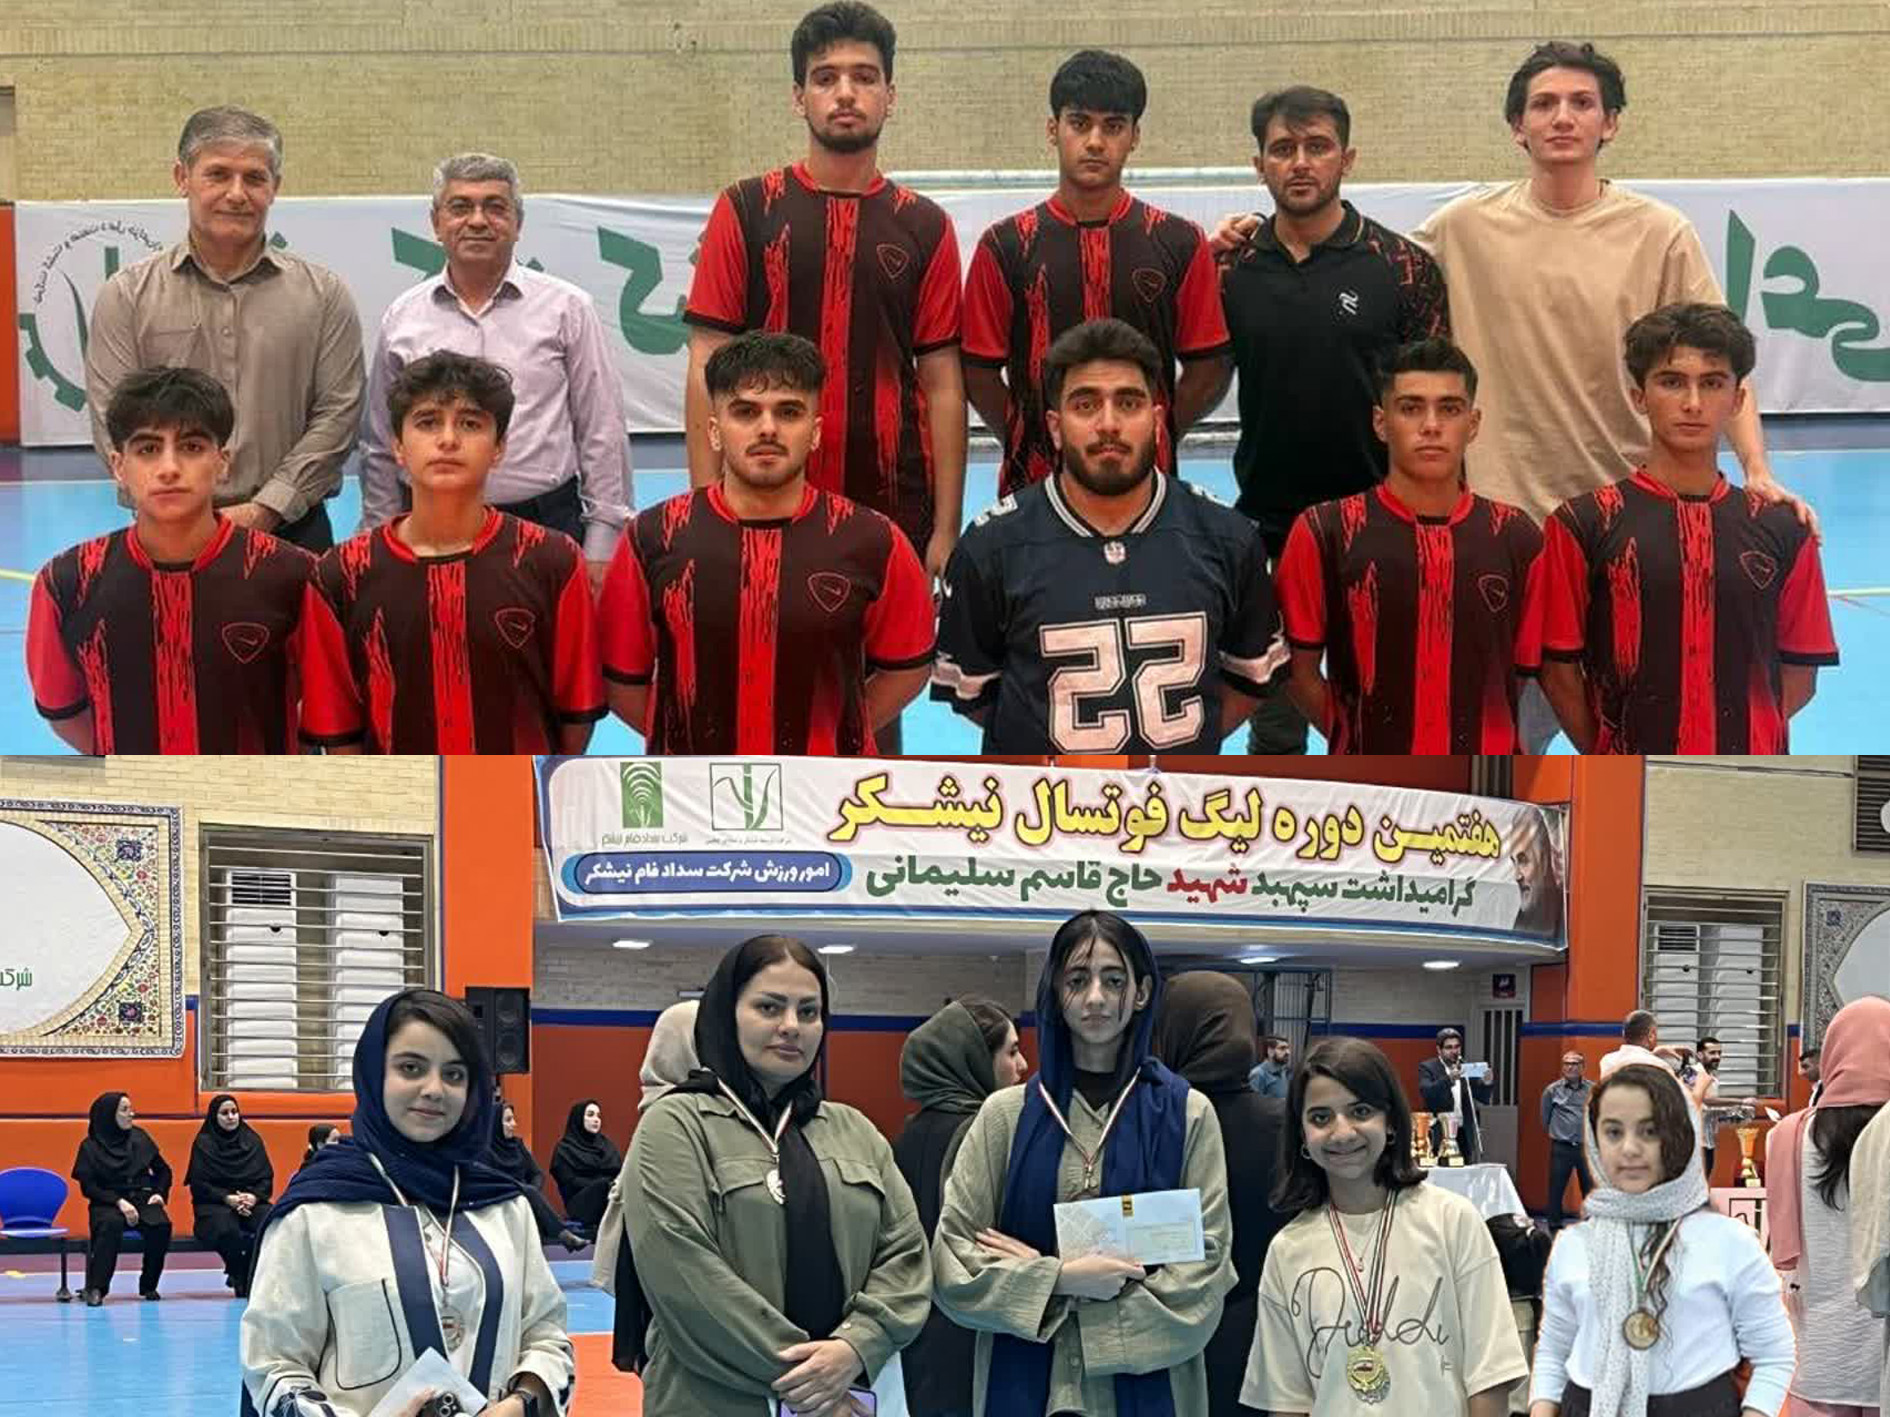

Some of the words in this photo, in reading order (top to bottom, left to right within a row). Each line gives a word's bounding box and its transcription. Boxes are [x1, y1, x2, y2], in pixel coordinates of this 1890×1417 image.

[826, 772, 1004, 843] نیشکر
[1013, 776, 1169, 853] فوتسال
[1177, 786, 1264, 855] لیگ
[1271, 804, 1366, 860] دوره
[1372, 807, 1501, 866] هفتمین
[584, 861, 634, 887] نیشکر
[634, 862, 660, 885] فام
[661, 861, 703, 879] سداد
[705, 858, 752, 883] شرکت
[754, 860, 800, 884] ورزش
[800, 862, 831, 884] امور
[866, 855, 1015, 897] سلیمانی
[1020, 860, 1102, 902] قاسم
[1105, 862, 1163, 908] حاج
[1166, 863, 1248, 903] شهید
[1251, 871, 1339, 913] سپهبد
[1341, 869, 1476, 917] گرامیداشت
[0, 967, 33, 991] شرک
